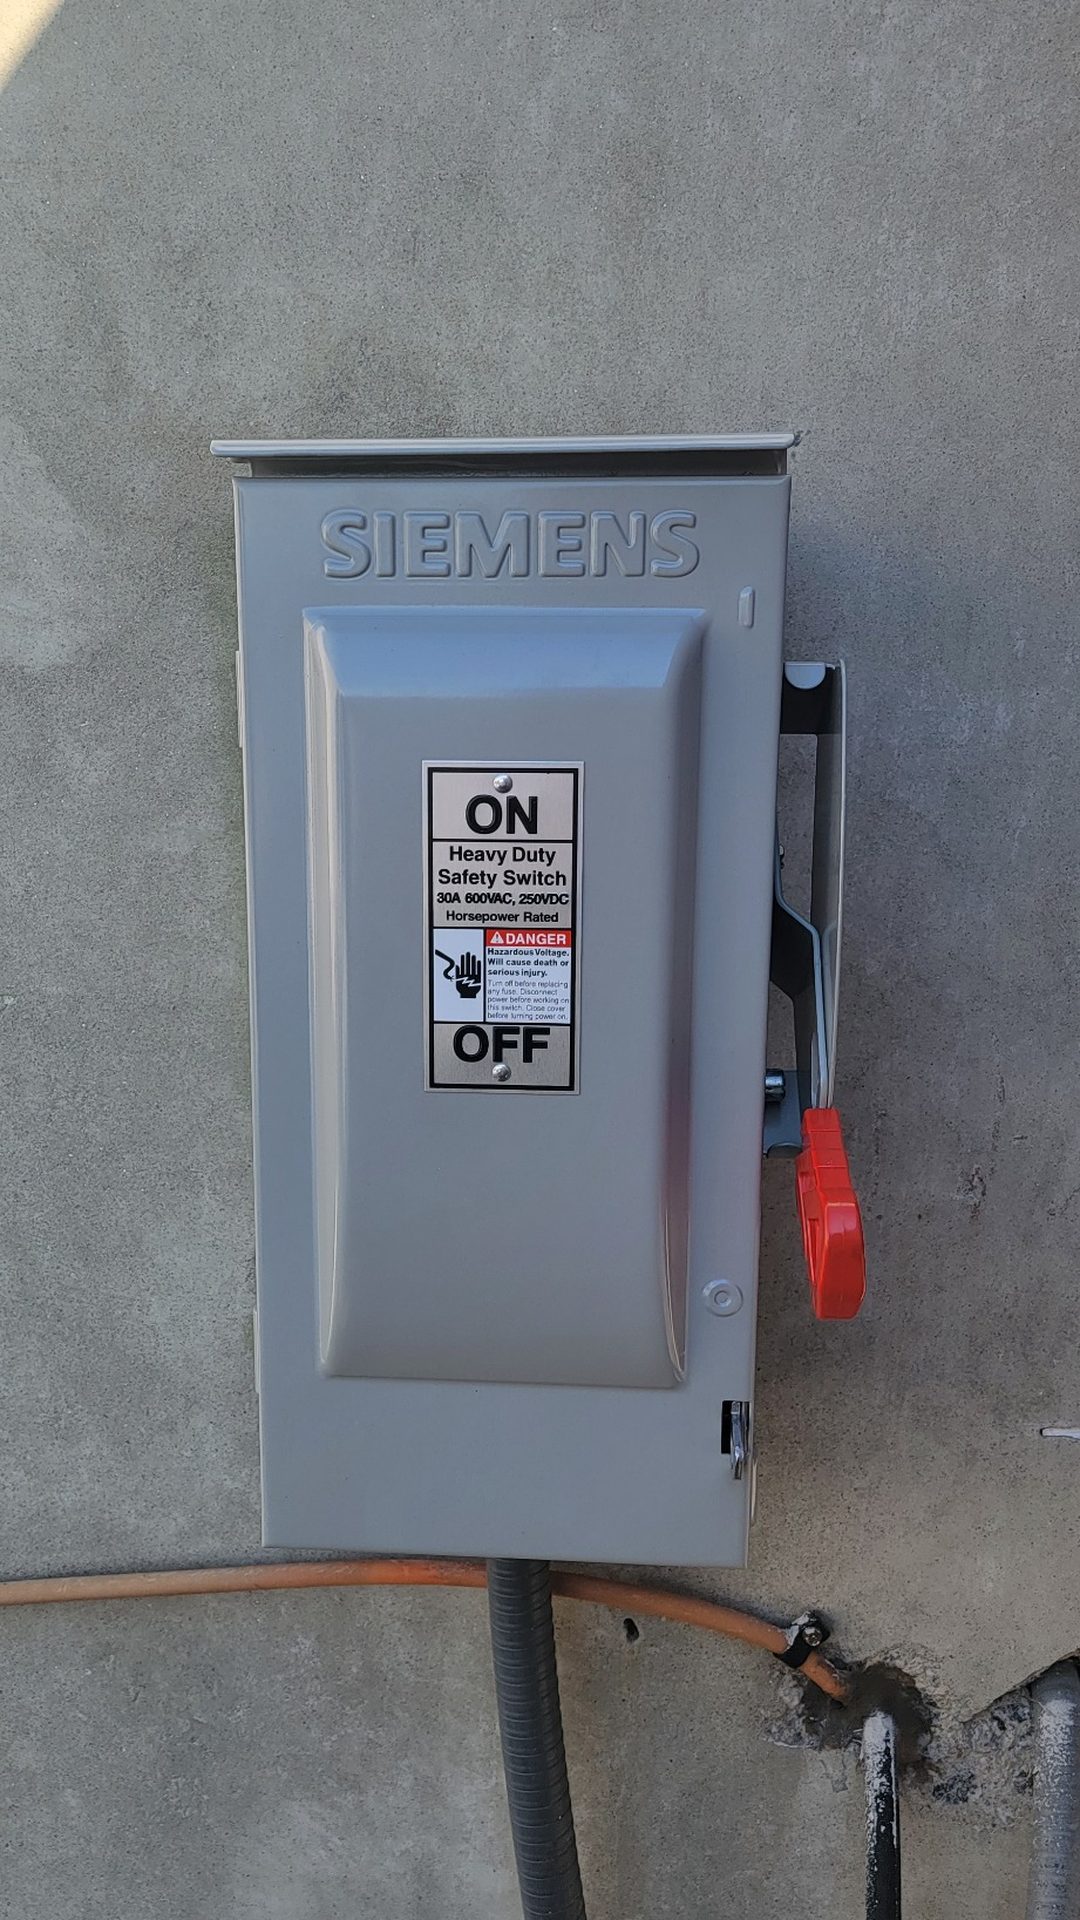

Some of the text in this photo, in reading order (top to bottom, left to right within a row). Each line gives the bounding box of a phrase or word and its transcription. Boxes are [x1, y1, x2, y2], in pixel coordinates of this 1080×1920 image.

[319, 508, 701, 580] SIEMENS
[465, 794, 538, 834] ON
[449, 845, 556, 867] Heavy Duty
[438, 869, 567, 889] Safety Switch
[437, 892, 569, 905] 30A 600VAC, 250VDC
[446, 910, 559, 923] Horsepower Rated
[505, 932, 567, 945] DANGER
[487, 948, 570, 958] Hazardous Voltage.
[487, 958, 504, 966] Will
[487, 968, 548, 978] serious injury.
[533, 997, 559, 1005] working
[453, 1024, 550, 1063] OFF
